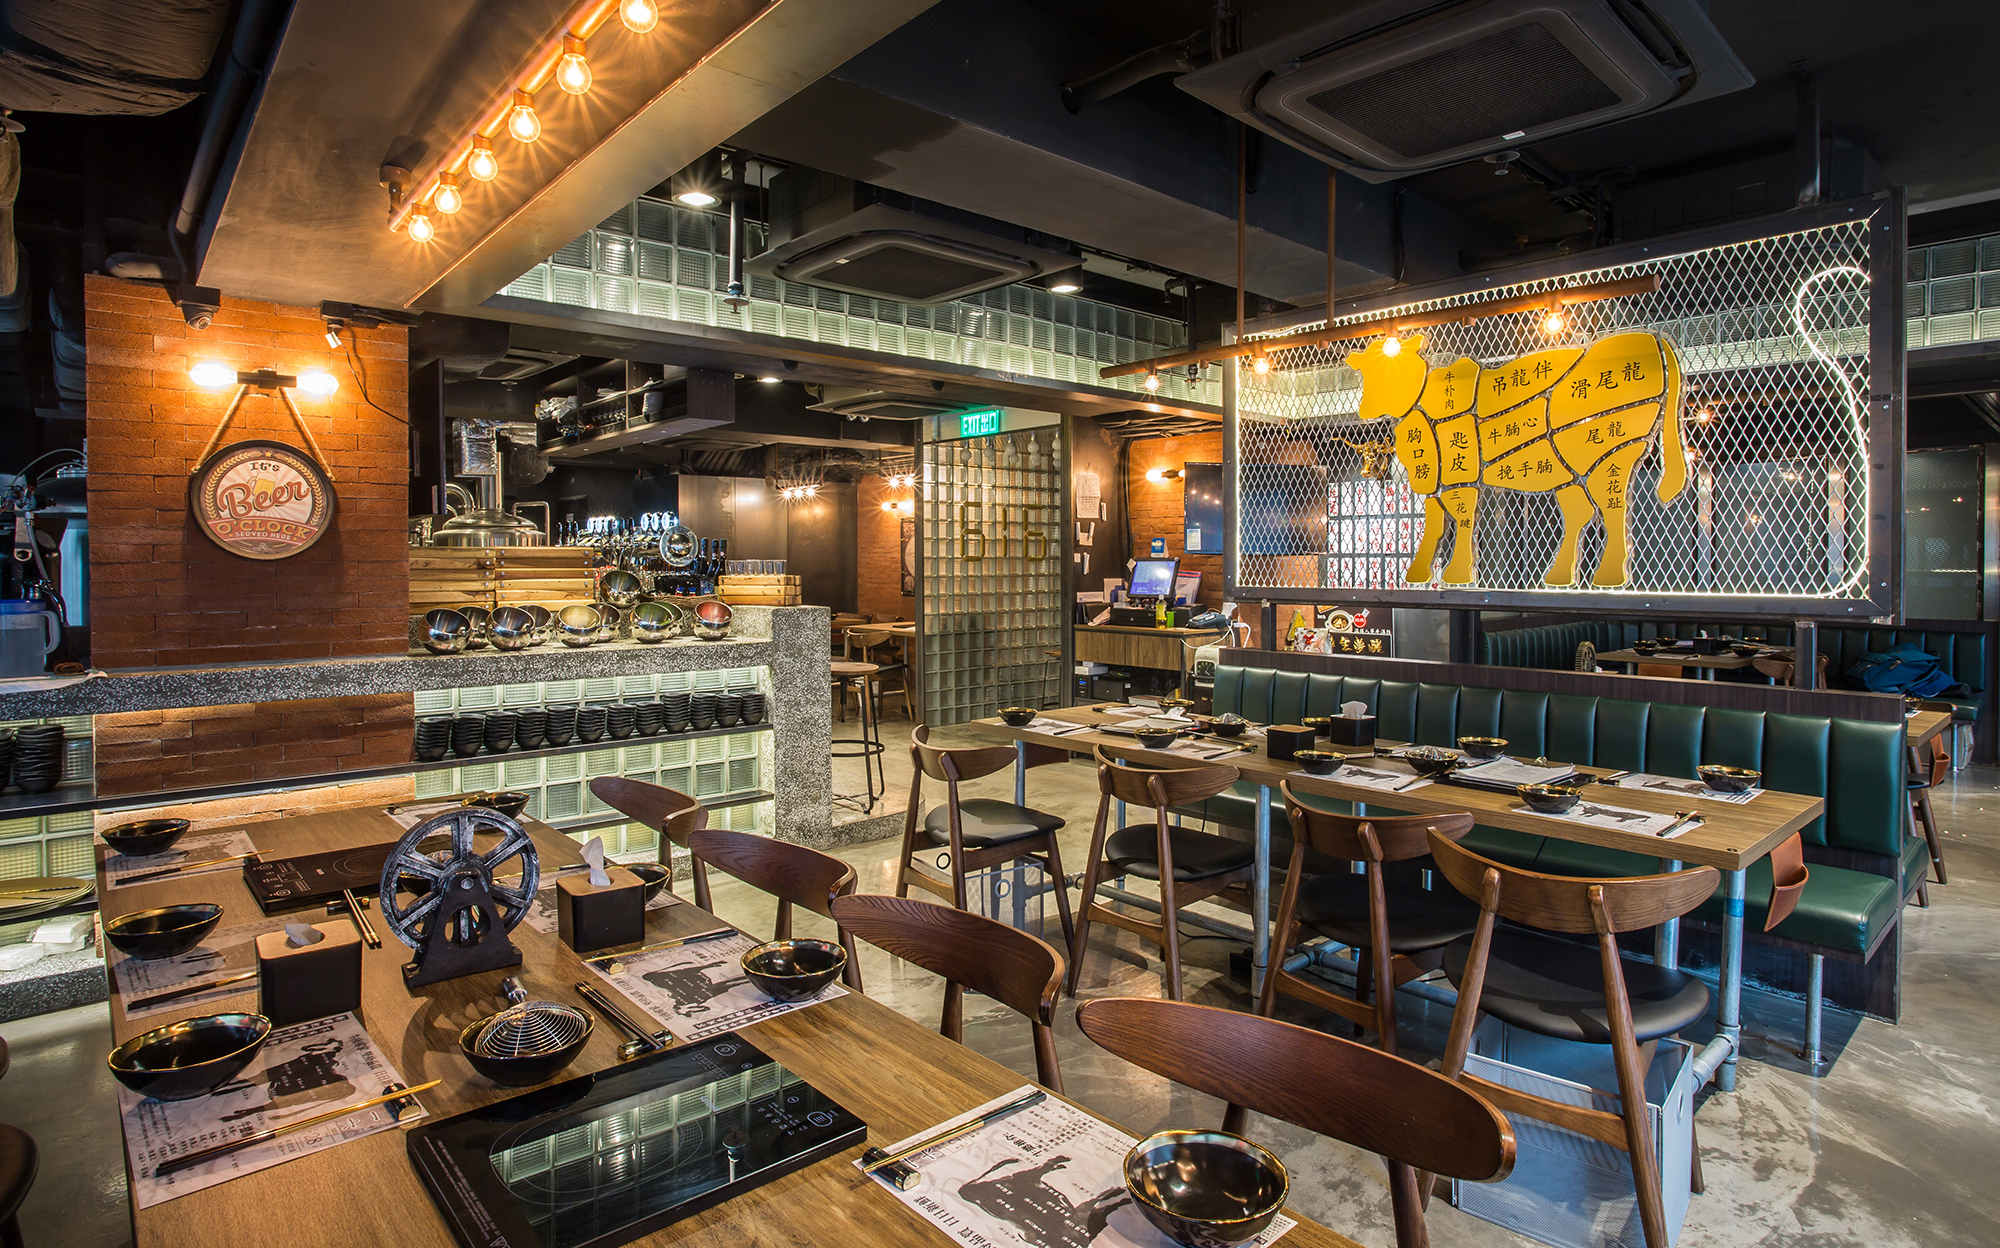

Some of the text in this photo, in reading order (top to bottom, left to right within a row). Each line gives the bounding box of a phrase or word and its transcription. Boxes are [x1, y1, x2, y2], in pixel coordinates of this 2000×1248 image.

[1492, 360, 1552, 396] 吊龍伴
[1570, 361, 1645, 399] 滑尾龍
[963, 412, 997, 434] EXIT 出口
[1487, 417, 1538, 445] 牛腩心
[1584, 421, 1626, 444] 尾龍
[1449, 431, 1469, 472] 匙皮
[250, 462, 280, 471] It's
[1496, 458, 1553, 480] 挽手腩
[217, 481, 311, 519] Beer
[1605, 463, 1622, 509] 金花趾
[216, 520, 310, 540] O'CLOCK
[270, 532, 291, 540] HERE
[959, 501, 1046, 562] 616
[373, 1069, 396, 1088] 日日新
[914, 1195, 959, 1226] 日日新鮮
